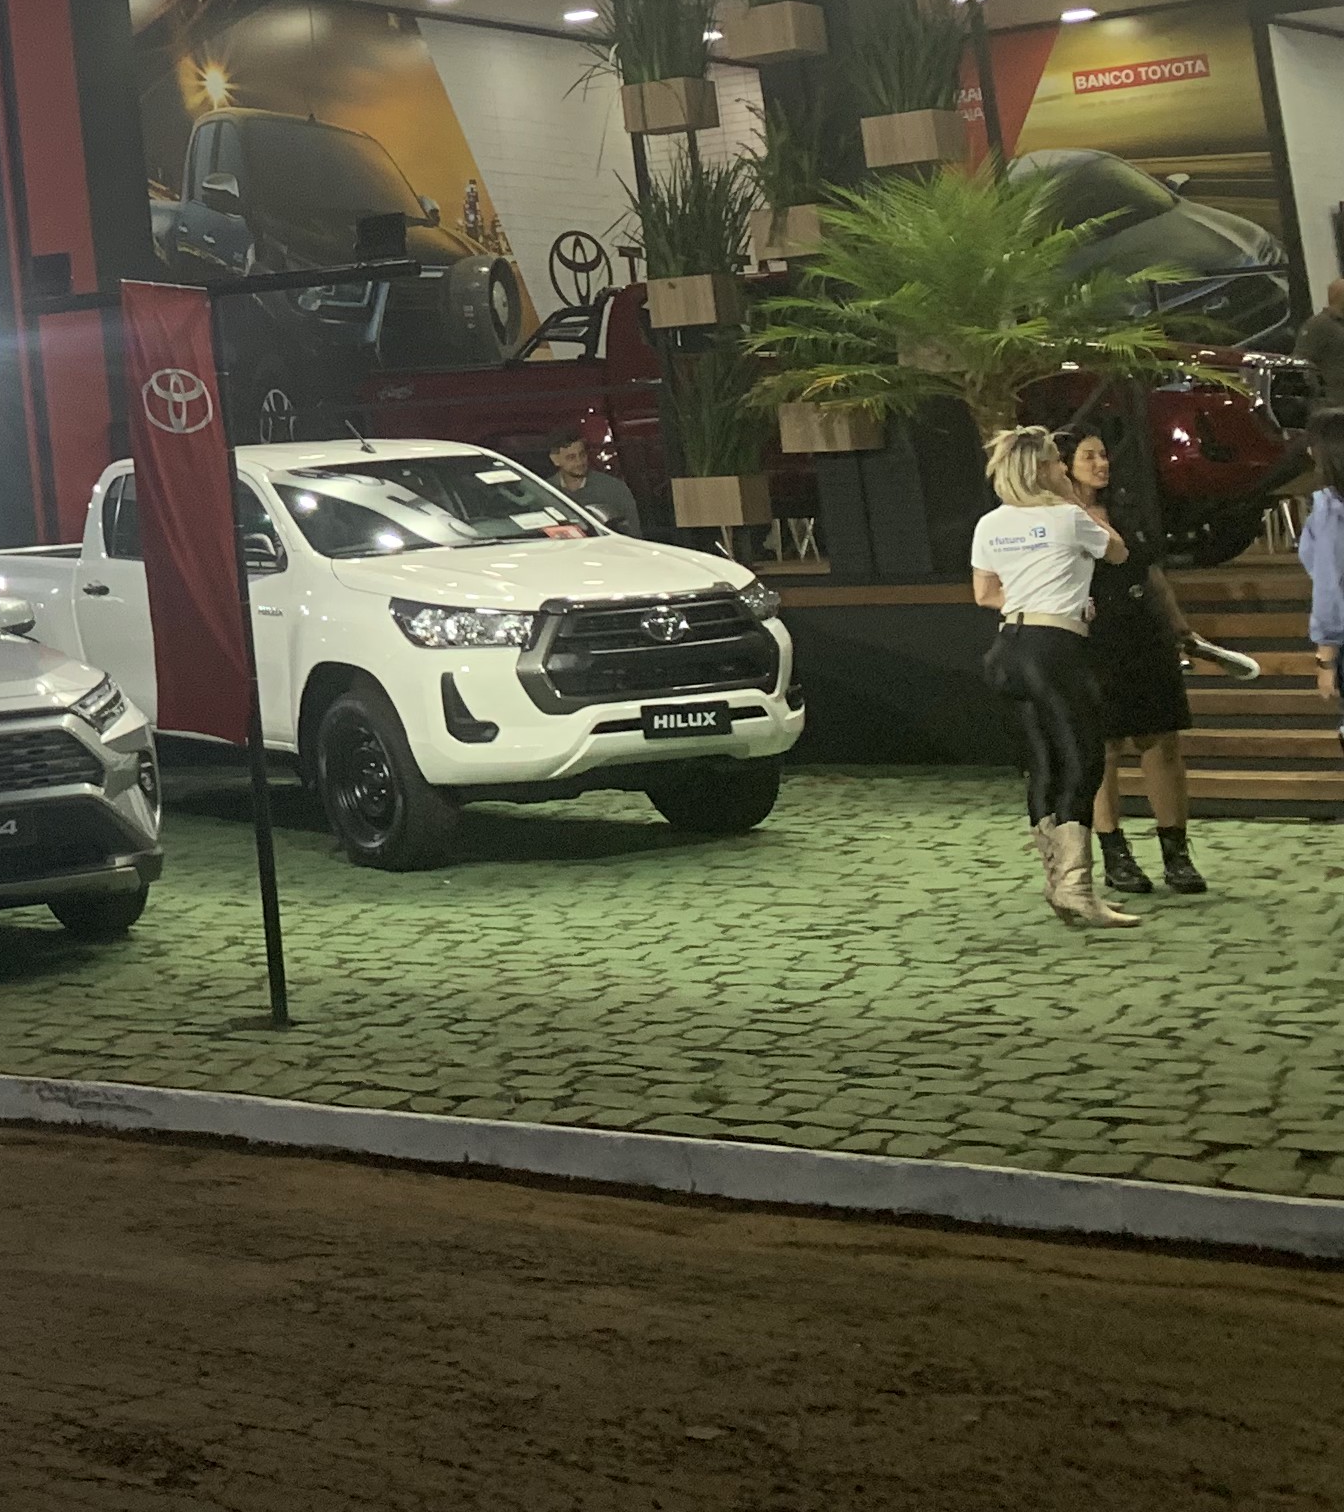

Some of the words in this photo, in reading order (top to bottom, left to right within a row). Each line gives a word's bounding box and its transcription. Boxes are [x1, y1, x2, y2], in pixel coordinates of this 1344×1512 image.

[1075, 69, 1134, 90] BANCO
[1137, 59, 1206, 81] TOYOTA
[654, 711, 716, 729] HILUX
